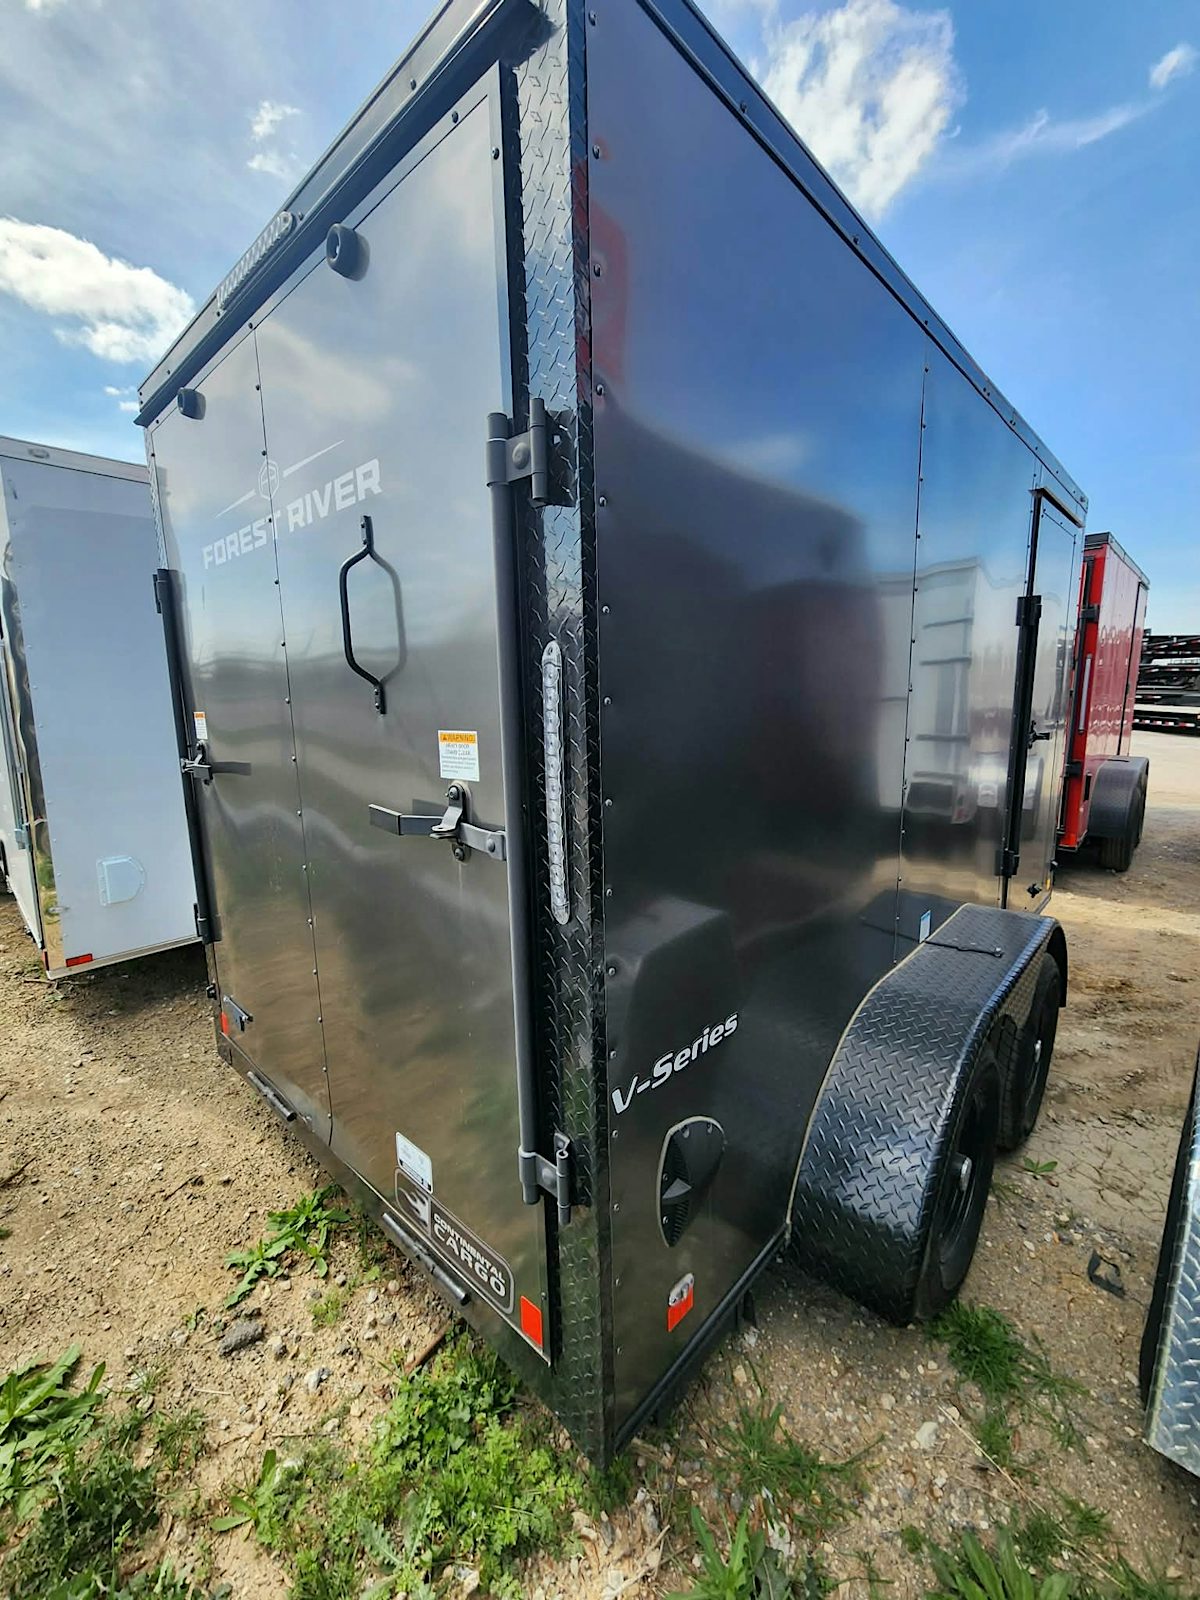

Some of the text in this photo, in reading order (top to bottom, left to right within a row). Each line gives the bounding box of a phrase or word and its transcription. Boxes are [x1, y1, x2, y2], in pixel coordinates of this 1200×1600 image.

[202, 458, 382, 570] FOREST RIVER
[611, 1013, 738, 1115] V-Series
[433, 1213, 506, 1284] CONTINENTAL
[433, 1223, 506, 1297] CARGO
